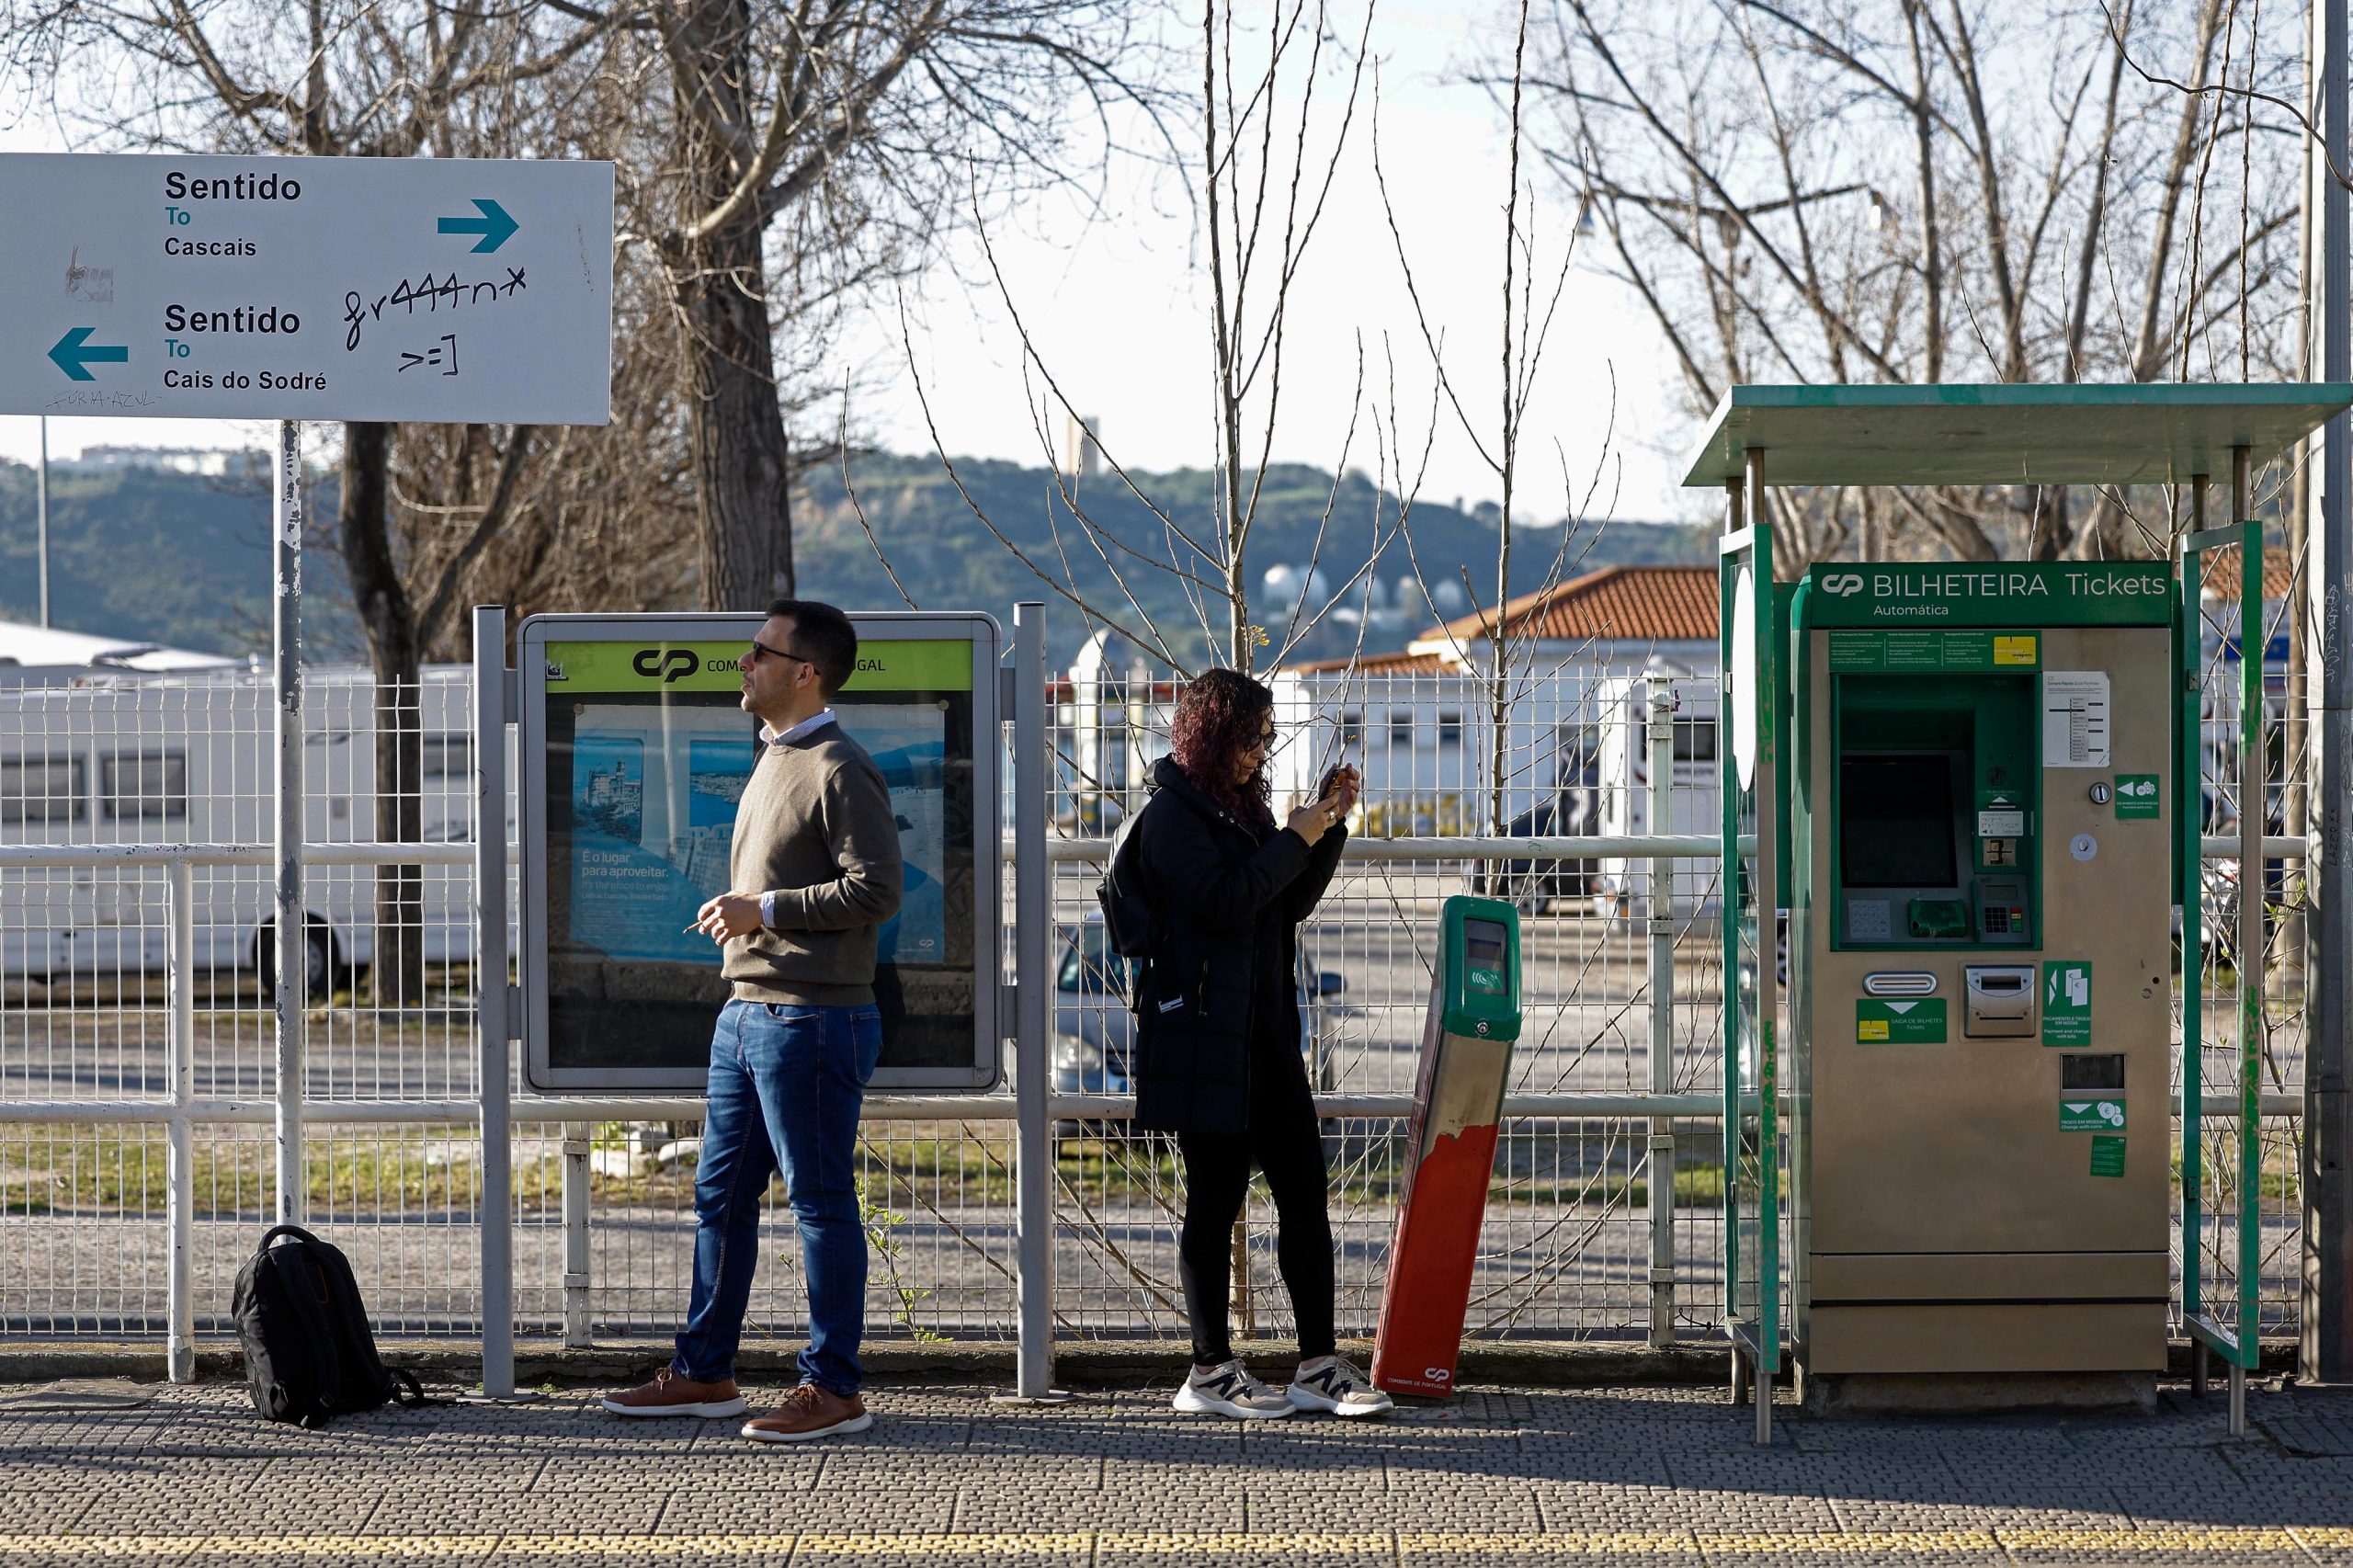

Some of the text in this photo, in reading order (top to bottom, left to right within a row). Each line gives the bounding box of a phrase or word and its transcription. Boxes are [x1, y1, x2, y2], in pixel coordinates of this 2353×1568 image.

[165, 171, 301, 200] Sentido
[165, 206, 191, 226] To
[165, 236, 256, 256] Cascais
[165, 303, 301, 334] Sentido
[164, 338, 190, 358] To
[164, 369, 326, 391] Cais do Sodré
[1874, 574, 2049, 597] BILHETEIRA
[2064, 572, 2165, 596] Tickets
[1873, 604, 1949, 616] Automática
[582, 849, 631, 865] É o lugar
[582, 866, 669, 879] para aproveitar.
[1387, 1377, 1413, 1386] COMBOIOS
[1421, 1381, 1448, 1390] PORTUGAL
